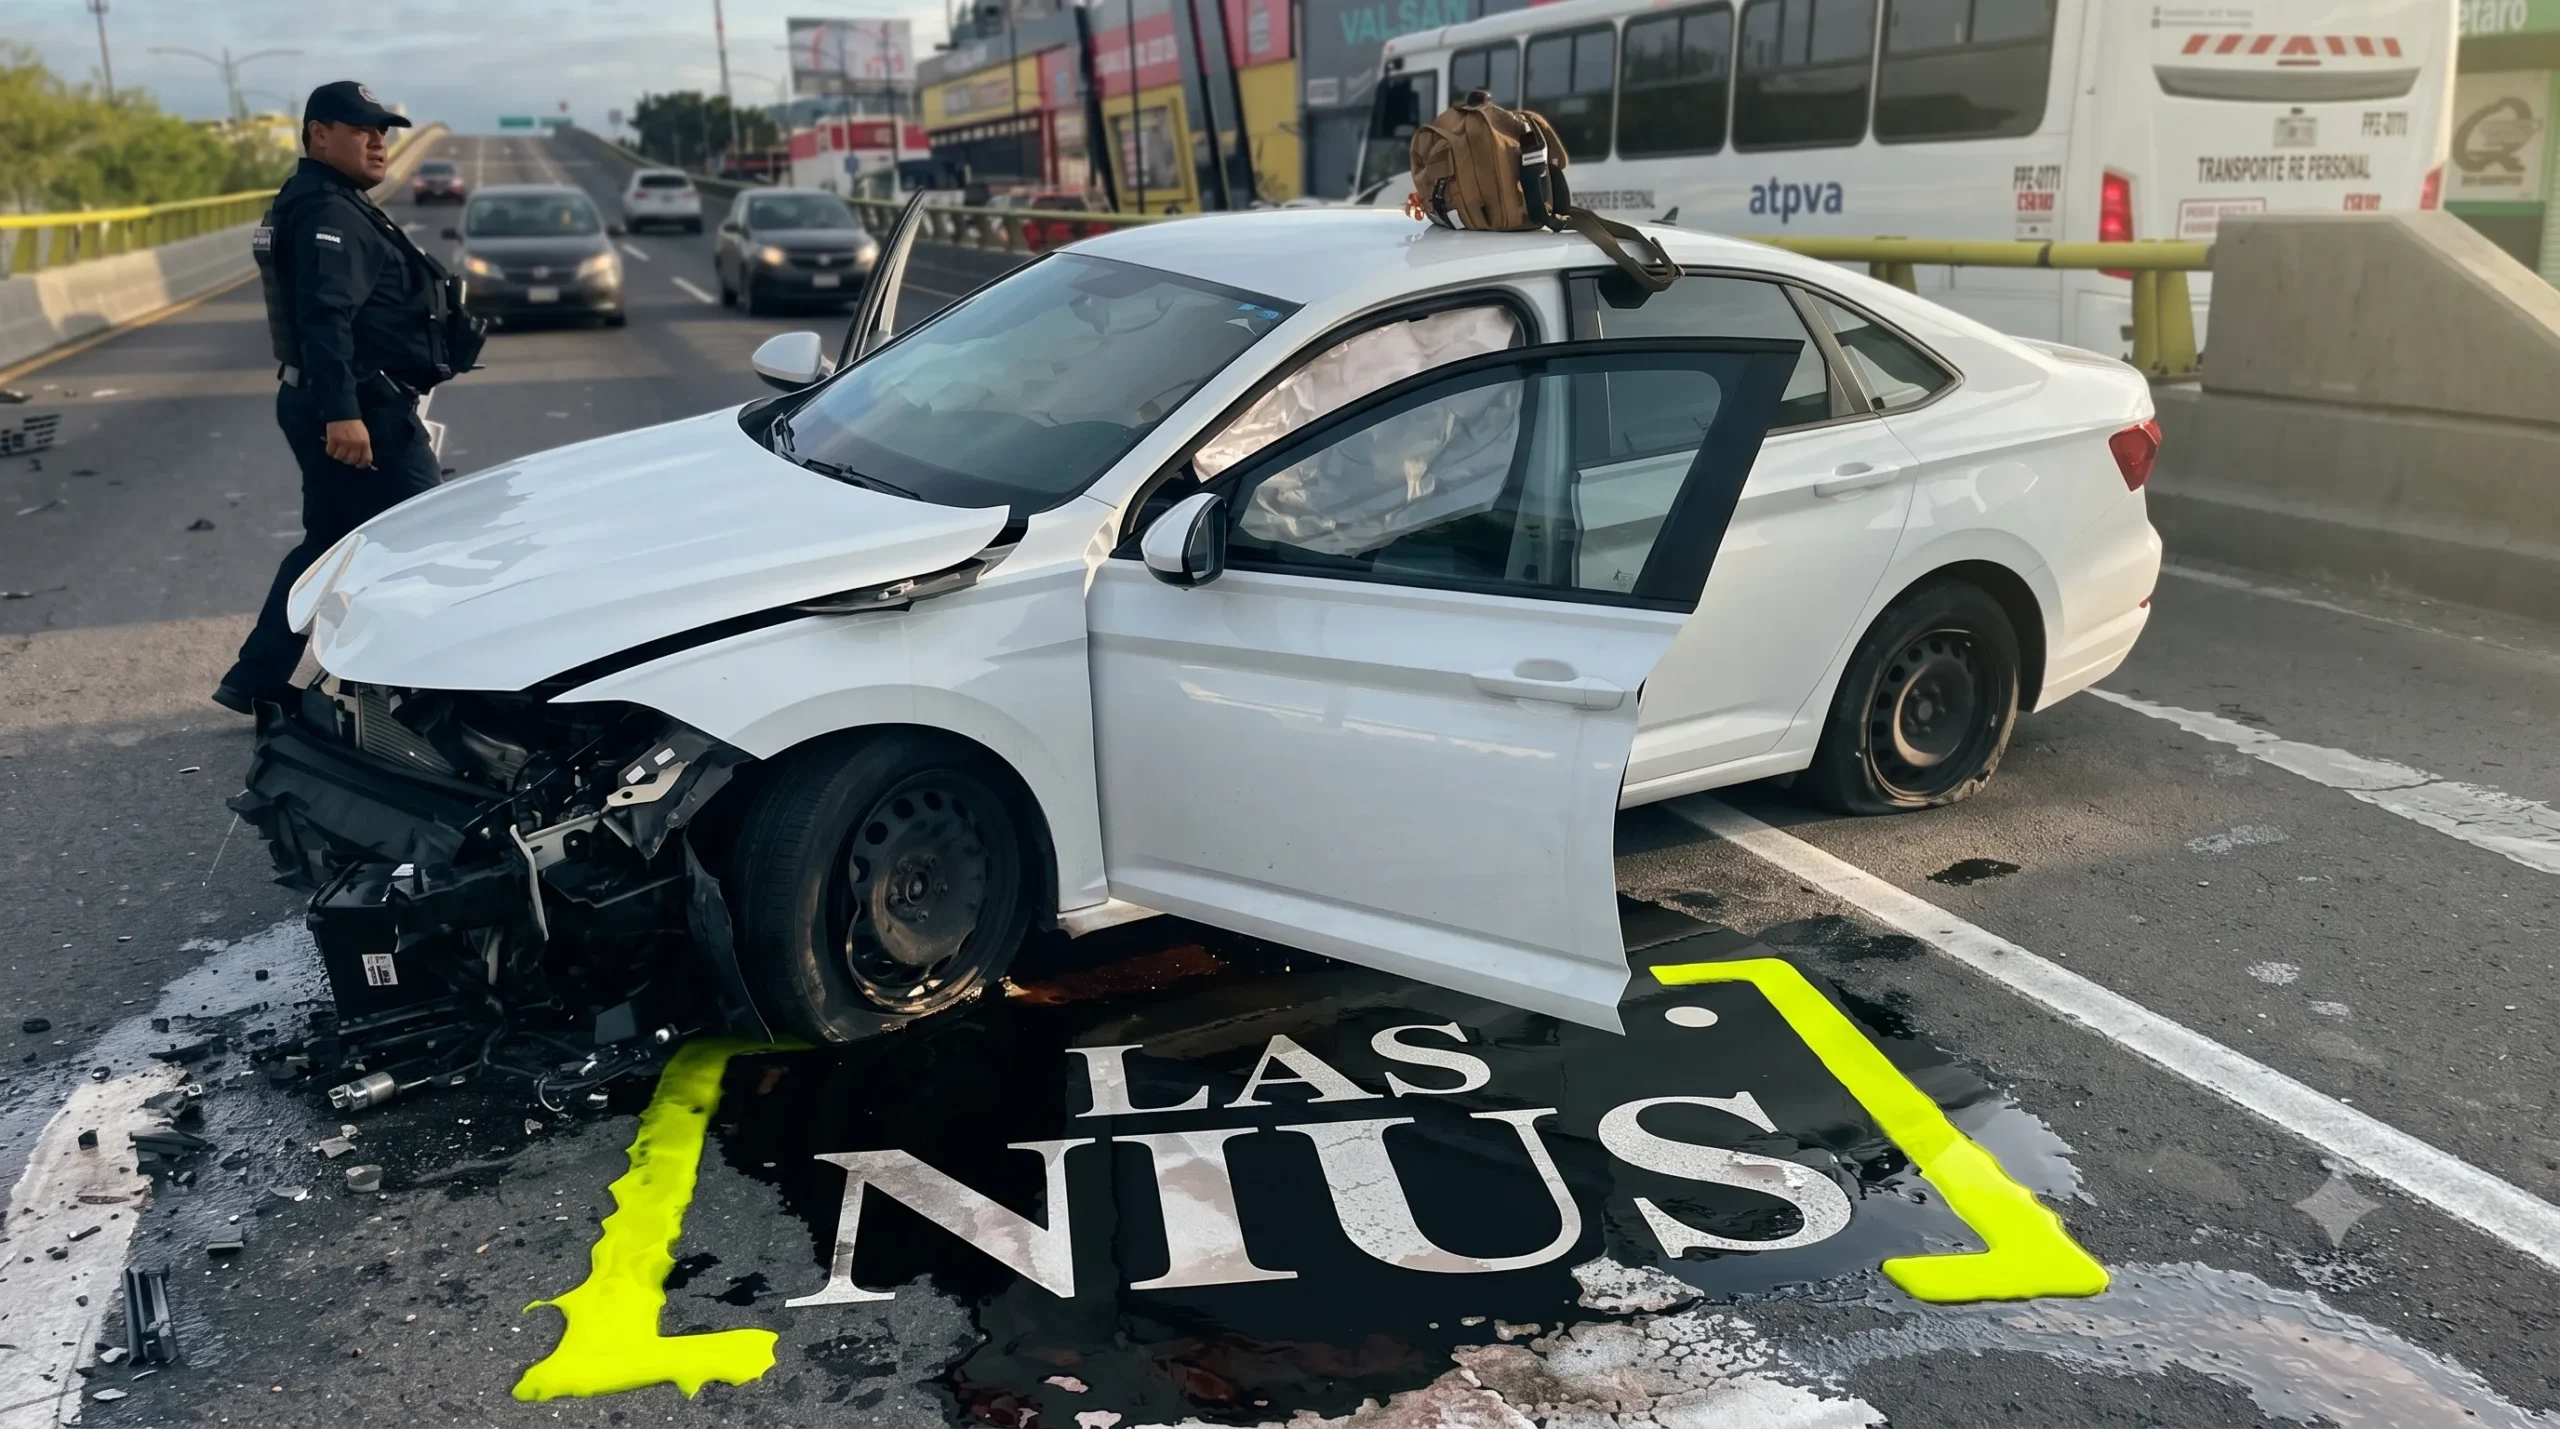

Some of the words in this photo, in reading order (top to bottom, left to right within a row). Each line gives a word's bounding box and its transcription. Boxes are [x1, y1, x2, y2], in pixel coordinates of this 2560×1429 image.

[2198, 157, 2285, 183] TRANSPORTE
[2309, 154, 2371, 180] PERSONAL
[1749, 176, 1844, 225] atpva
